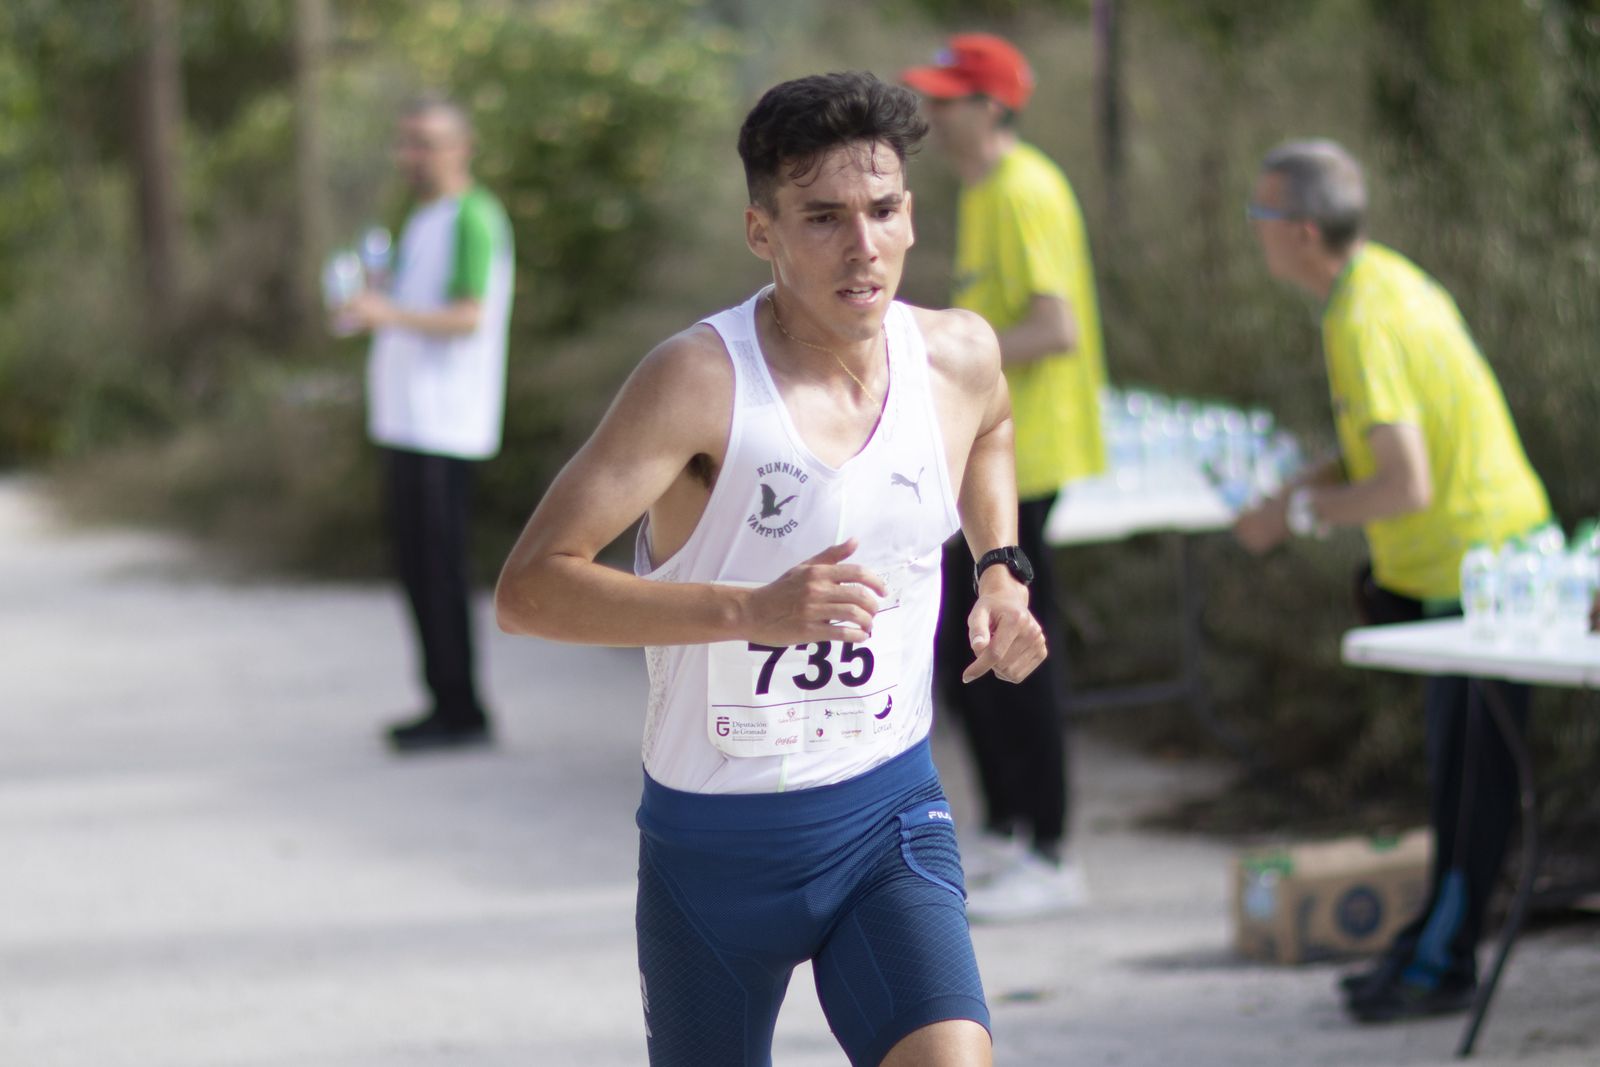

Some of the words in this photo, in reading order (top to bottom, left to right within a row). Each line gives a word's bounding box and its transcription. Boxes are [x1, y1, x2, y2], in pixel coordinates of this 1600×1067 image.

[757, 461, 809, 484] RUNNING
[747, 513, 799, 539] VAMPIROS
[748, 639, 875, 696] 735
